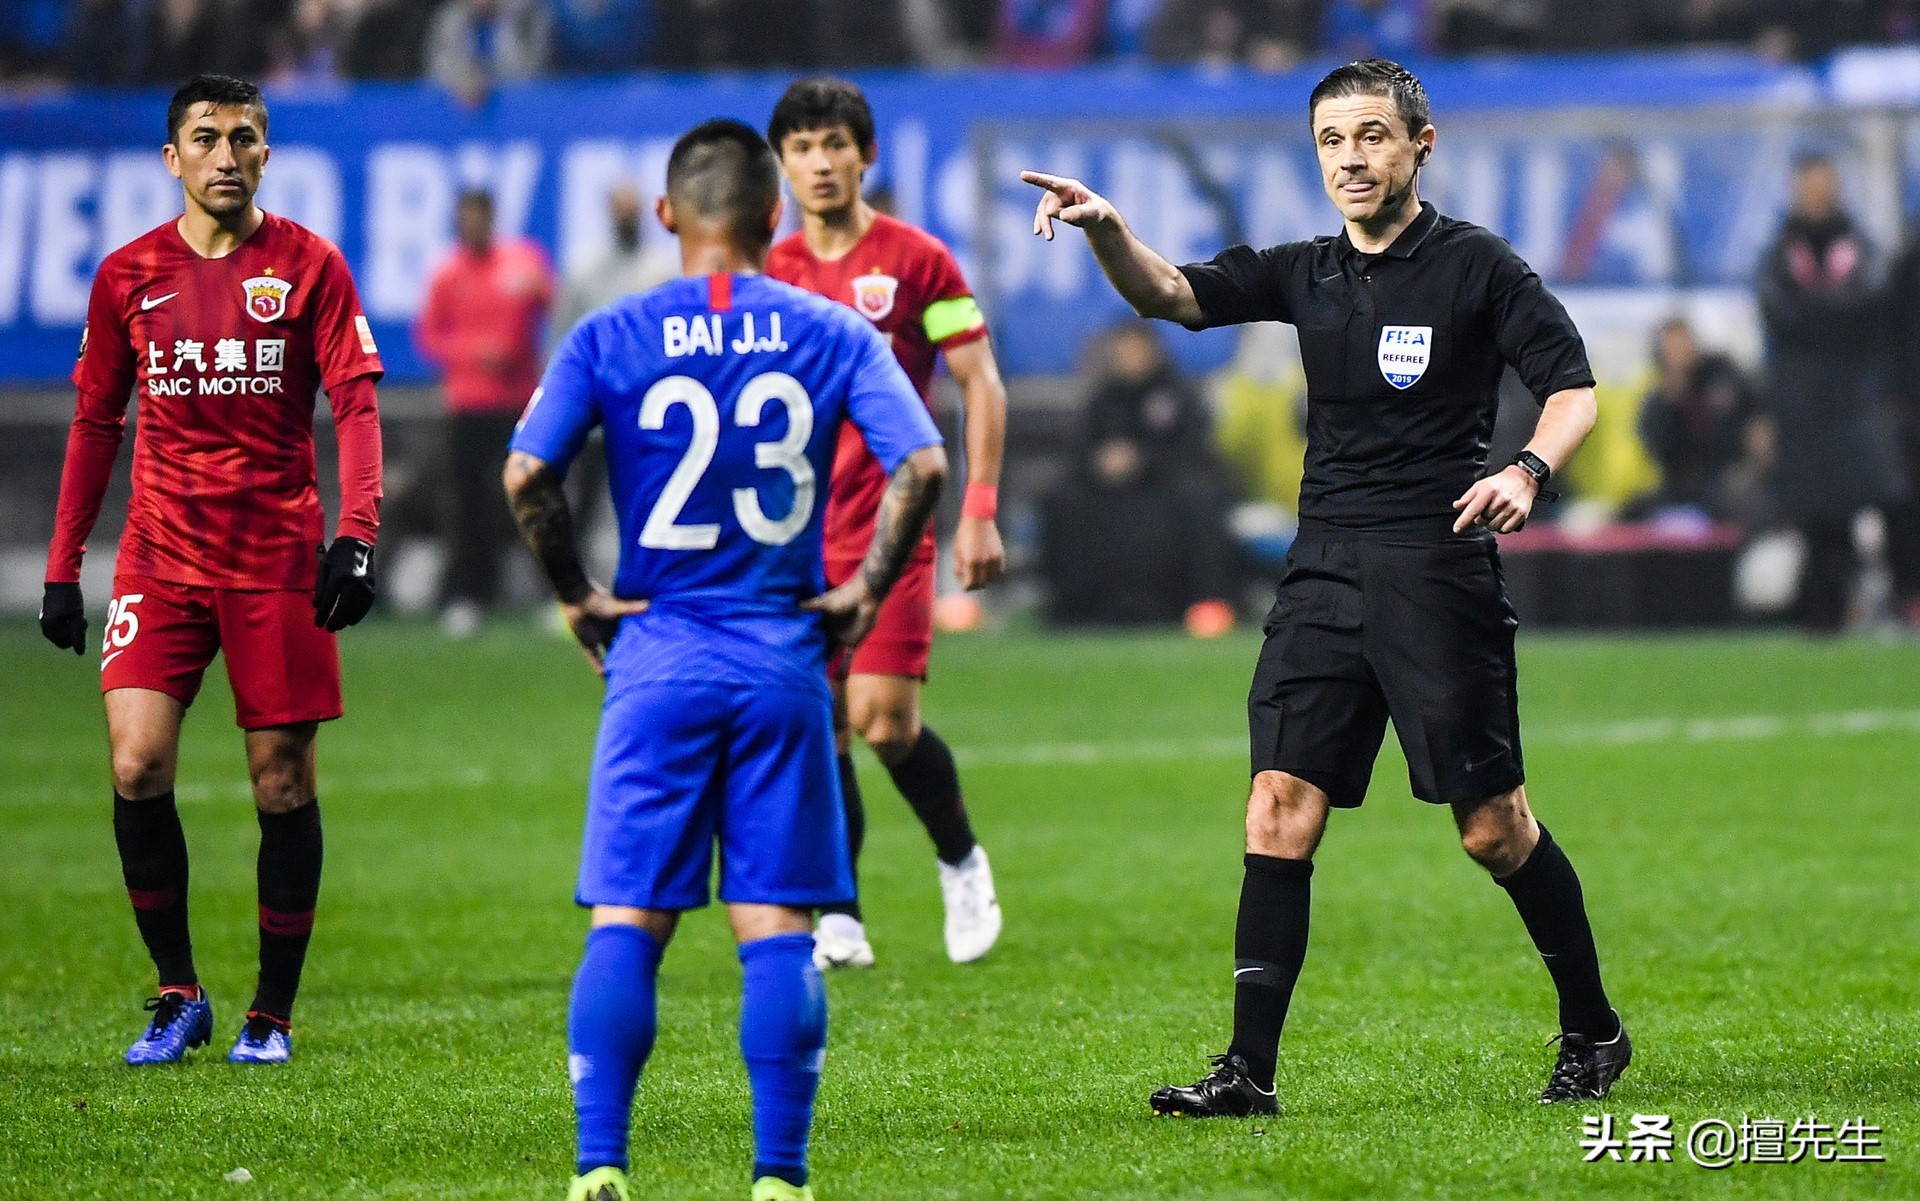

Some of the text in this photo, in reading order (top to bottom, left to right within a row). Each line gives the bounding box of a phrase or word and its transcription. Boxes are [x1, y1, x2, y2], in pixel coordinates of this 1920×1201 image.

[662, 311, 789, 357] BAI J.J.
[147, 337, 286, 375] 上汽集团
[1382, 353, 1425, 365] REFEREE
[147, 376, 284, 396] SAIC MOTOR
[1391, 374, 1413, 384] 2019
[637, 371, 817, 551] 23
